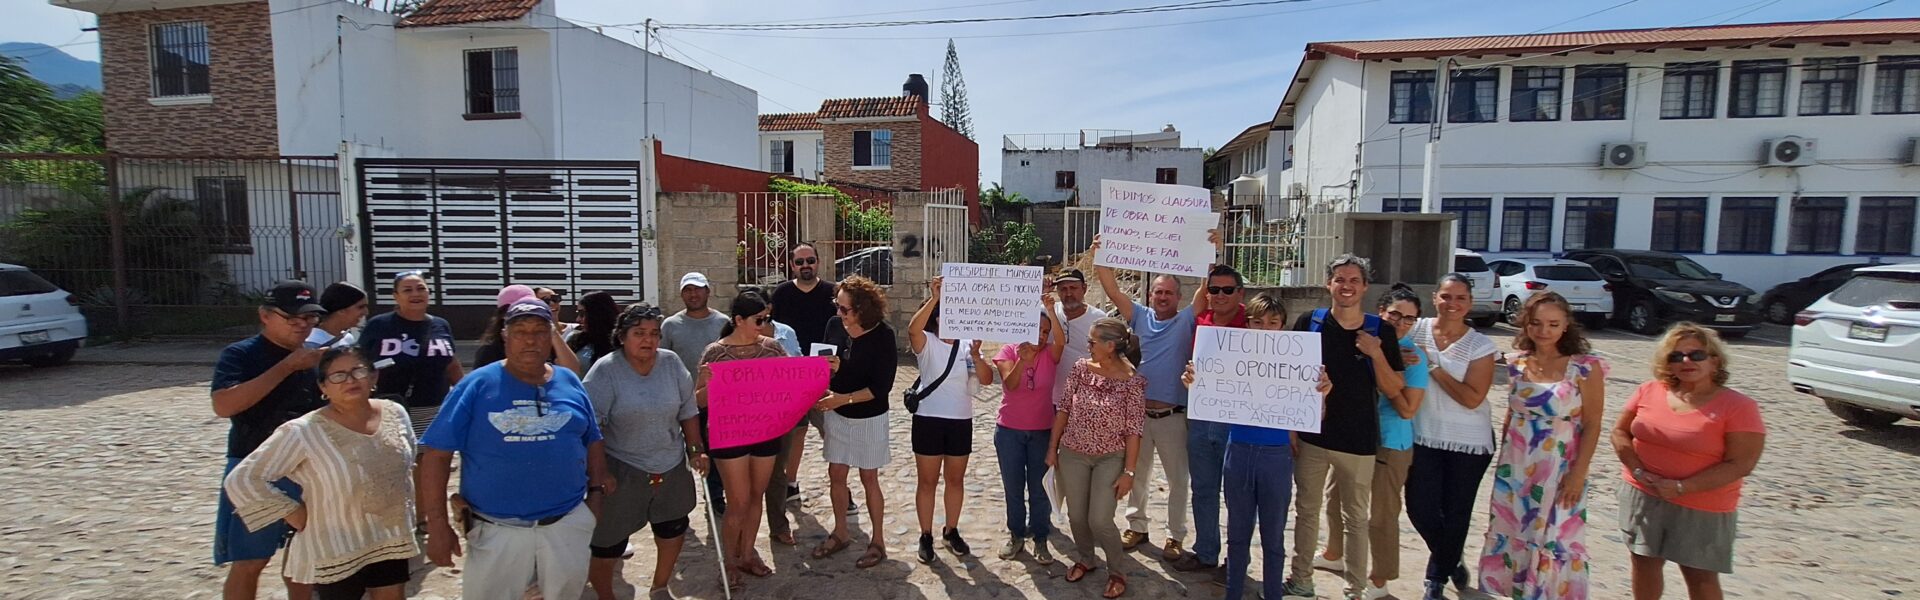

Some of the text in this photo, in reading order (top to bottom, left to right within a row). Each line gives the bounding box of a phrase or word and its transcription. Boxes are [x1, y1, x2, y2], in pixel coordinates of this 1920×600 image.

[1110, 186, 1210, 208] PEDIMOS CLAUSURA
[1106, 207, 1118, 218] DE
[1122, 209, 1149, 221] OBRA
[1154, 214, 1168, 223] DE
[1105, 240, 1142, 252] PADRES
[1146, 246, 1157, 256] DE
[1106, 253, 1193, 273] COLONIAS DE LA ZONA
[949, 265, 998, 278] PRESIDENTE
[945, 282, 1040, 293] ESTA OBRA ES NOCIVA
[945, 296, 966, 304] PARA
[967, 297, 977, 305] LA
[981, 297, 1031, 307] COMUNIDAD
[958, 308, 980, 316] MEDIO
[984, 309, 1025, 318] AMBIENTE
[1216, 329, 1303, 357] VECINOS
[770, 366, 827, 381] ANTENA
[1196, 357, 1320, 382] NOS OPONEMOS
[737, 390, 793, 405] EJECUTA
[1196, 376, 1317, 404] A ESTA OBRA
[1219, 410, 1305, 426] DE ANTENA
